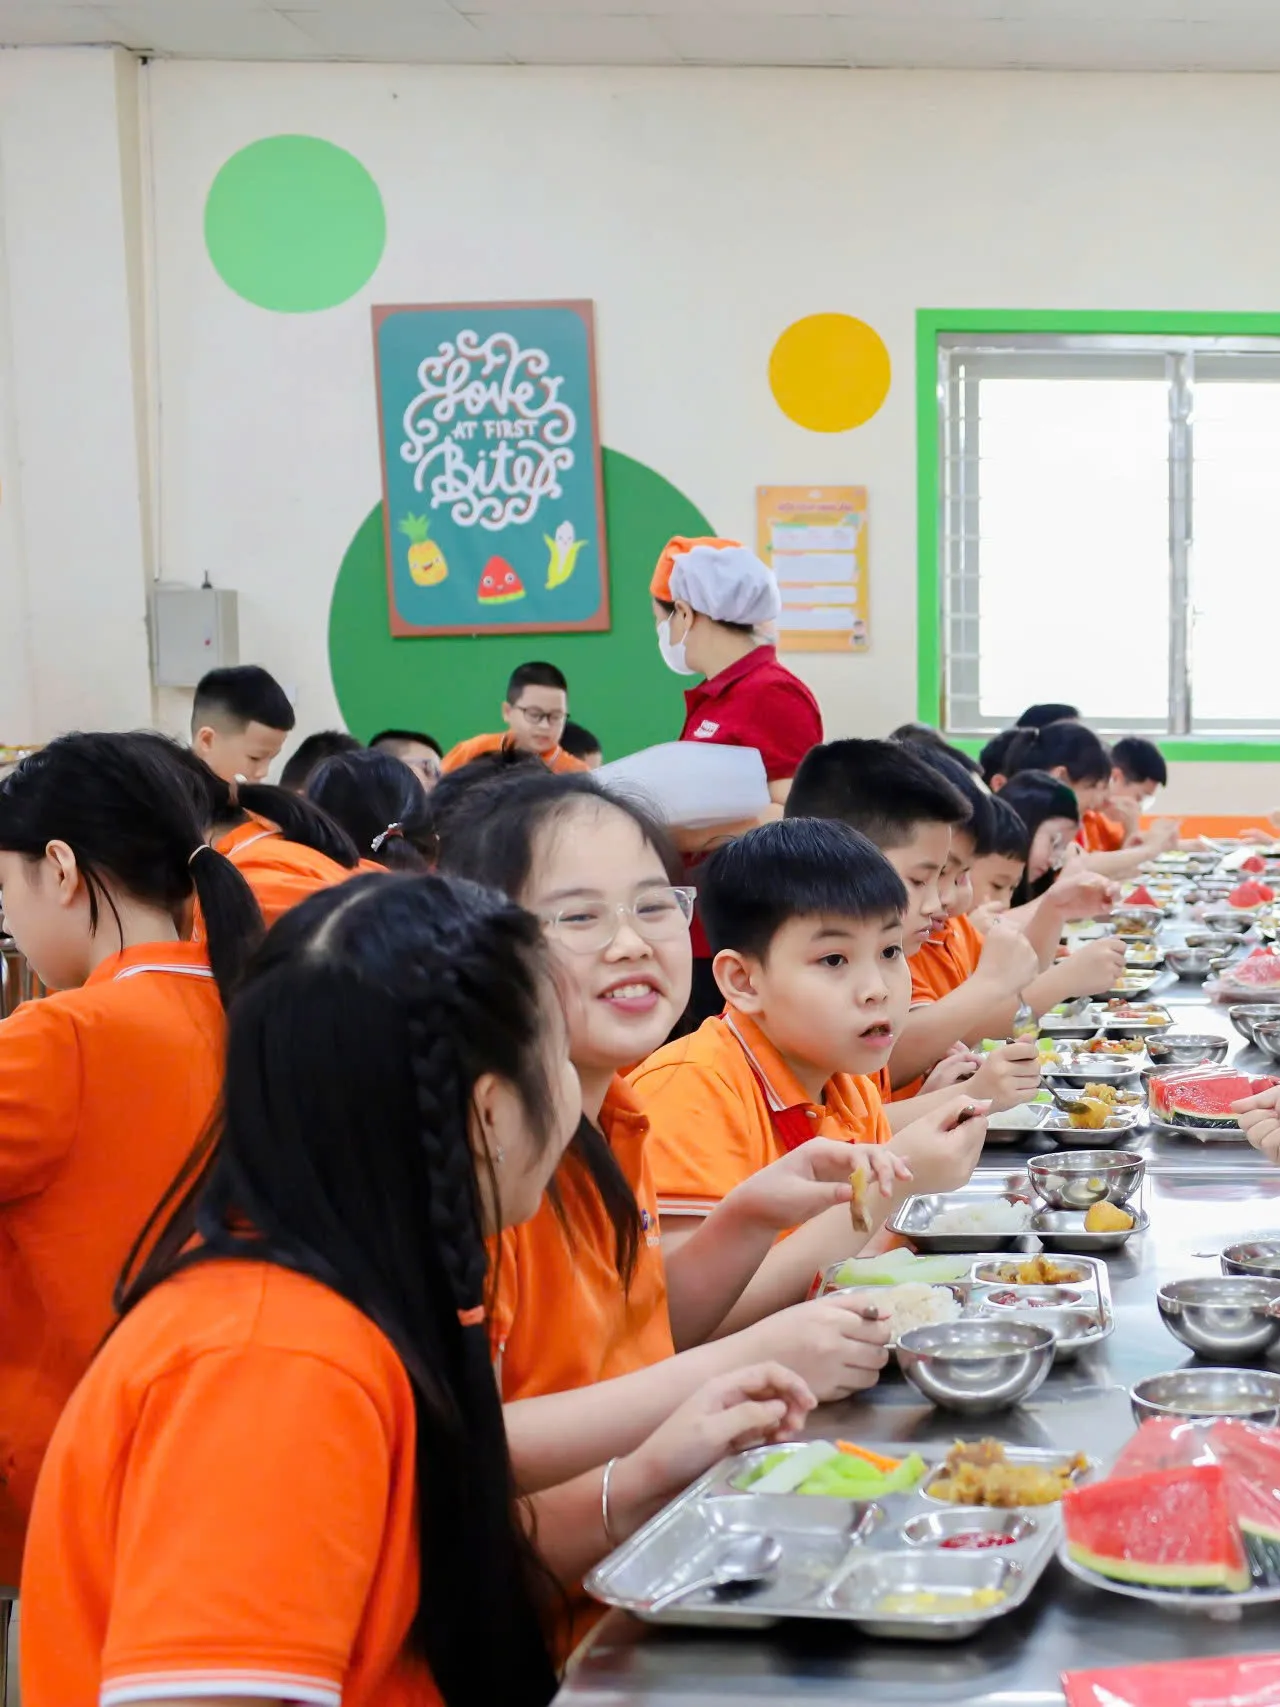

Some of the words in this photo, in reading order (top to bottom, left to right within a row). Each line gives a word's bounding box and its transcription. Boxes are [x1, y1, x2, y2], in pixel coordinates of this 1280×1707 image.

[408, 330, 570, 424] Love
[452, 421, 477, 440] AT
[483, 419, 540, 440] FIRST
